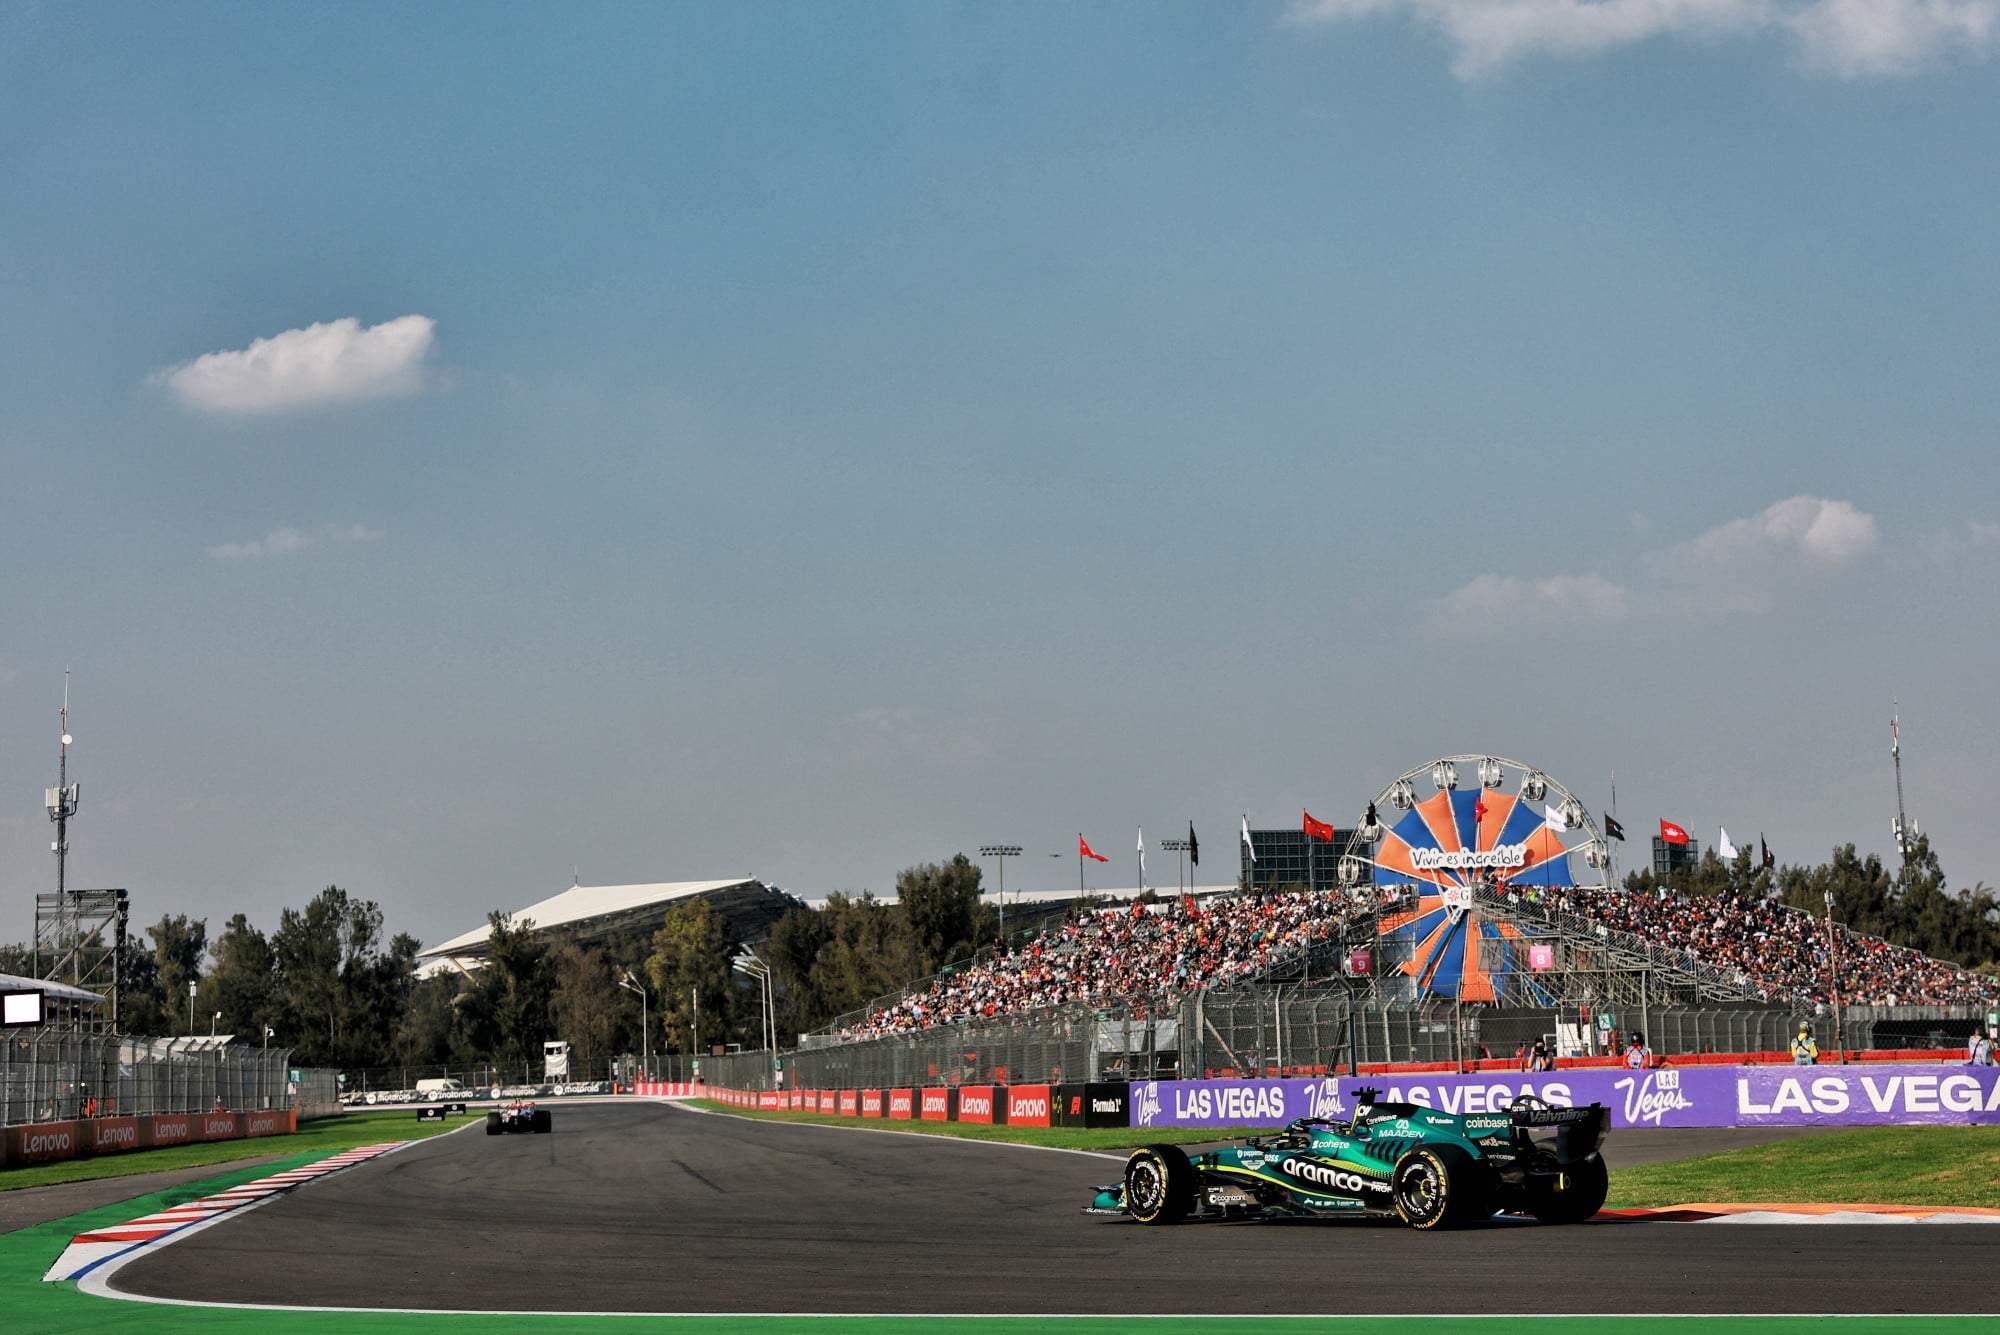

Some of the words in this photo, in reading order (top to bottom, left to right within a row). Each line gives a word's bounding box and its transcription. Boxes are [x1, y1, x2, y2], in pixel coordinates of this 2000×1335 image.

[1412, 850, 1443, 866] Vivir
[1447, 854, 1459, 865] es
[1358, 960, 1366, 970] 9
[1536, 955, 1545, 965] 8
[438, 1089, 474, 1099] motorola
[922, 1094, 946, 1112] Lenovo
[1176, 1089, 1212, 1119] LAS
[1214, 1086, 1285, 1119] VEGAS
[1304, 1081, 1346, 1119] Vegas
[1614, 1073, 1694, 1126] Vegas
[1737, 1077, 1850, 1114] LAS
[863, 1096, 881, 1111] Lenovo
[891, 1095, 911, 1112] Lenovo
[961, 1097, 990, 1116] Lenovo
[1010, 1095, 1046, 1118] Lenovo
[1092, 1098, 1115, 1113] Formula
[1135, 1084, 1162, 1126] Vegas
[155, 1120, 187, 1139] Lenovo
[205, 1118, 233, 1134] Lenovo
[249, 1118, 274, 1132] Lenovo
[1465, 1117, 1508, 1129] coinbase
[23, 1132, 70, 1154] Lenovo
[96, 1126, 135, 1145] Lenovo
[1283, 1158, 1363, 1192] aramco
